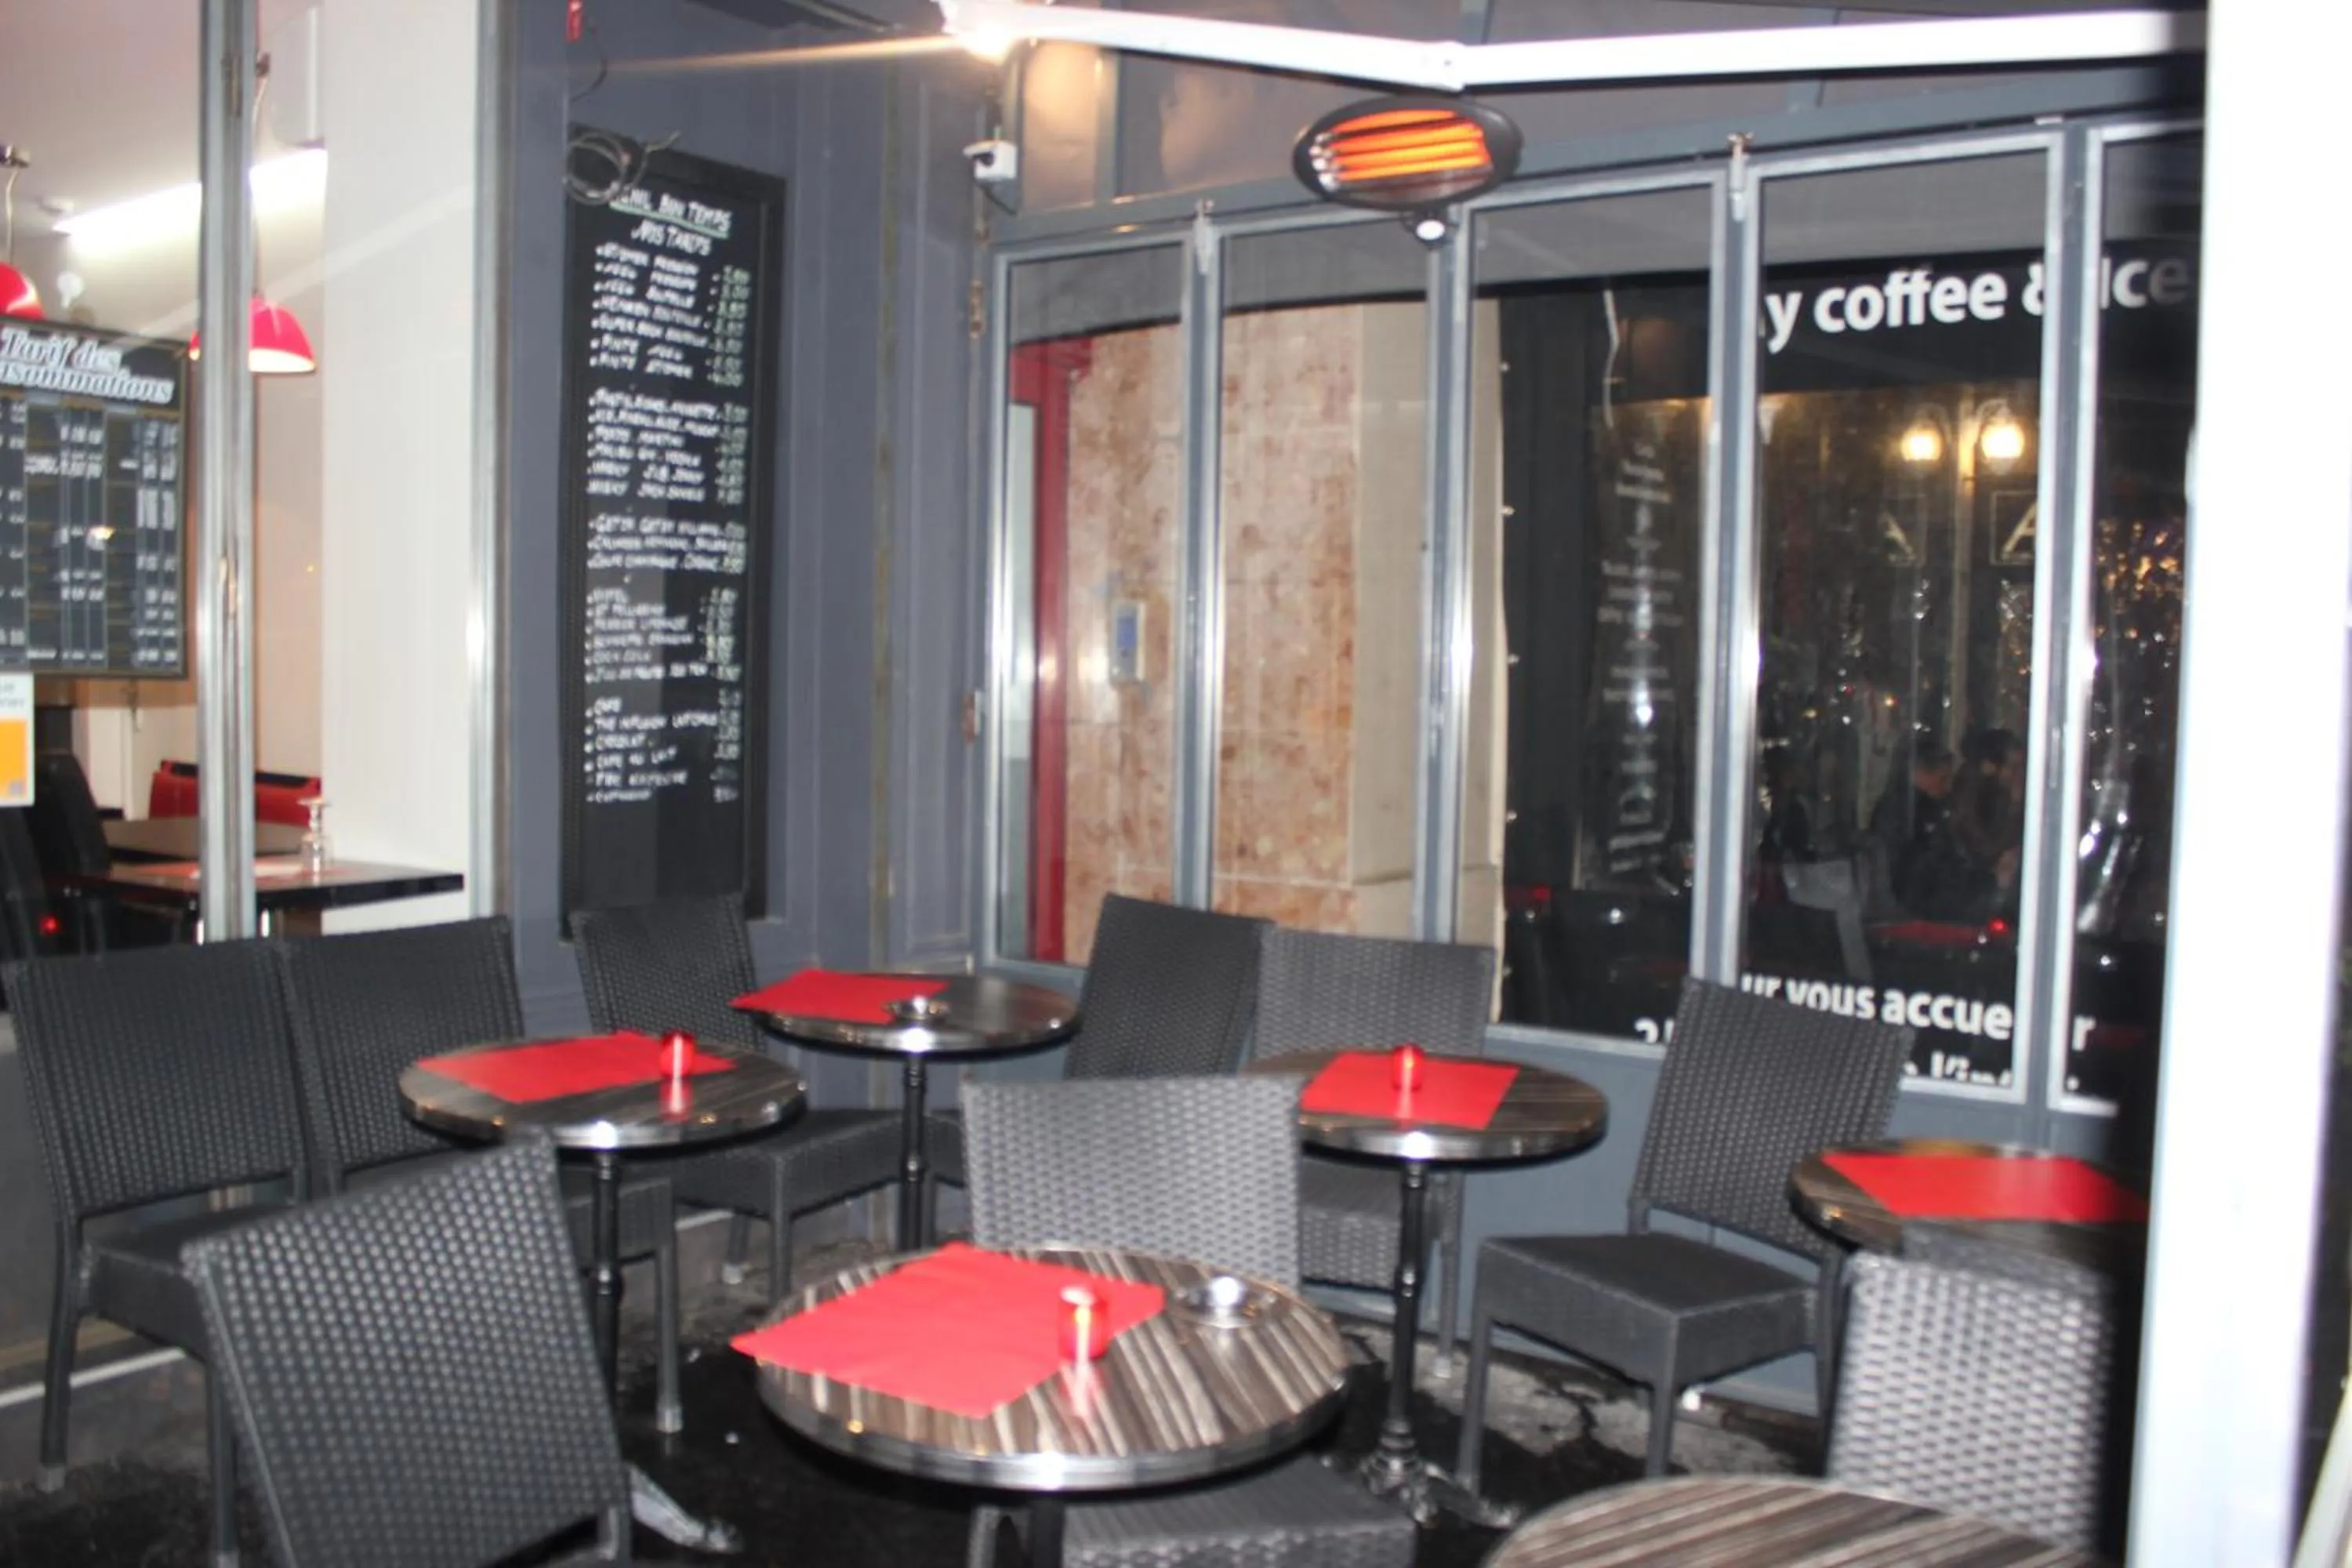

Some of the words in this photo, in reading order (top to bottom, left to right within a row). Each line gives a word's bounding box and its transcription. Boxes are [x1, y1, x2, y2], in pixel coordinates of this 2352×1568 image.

[1759, 292, 1802, 354] y
[1814, 268, 2007, 333] coffee
[1786, 975, 1878, 1020] vous
